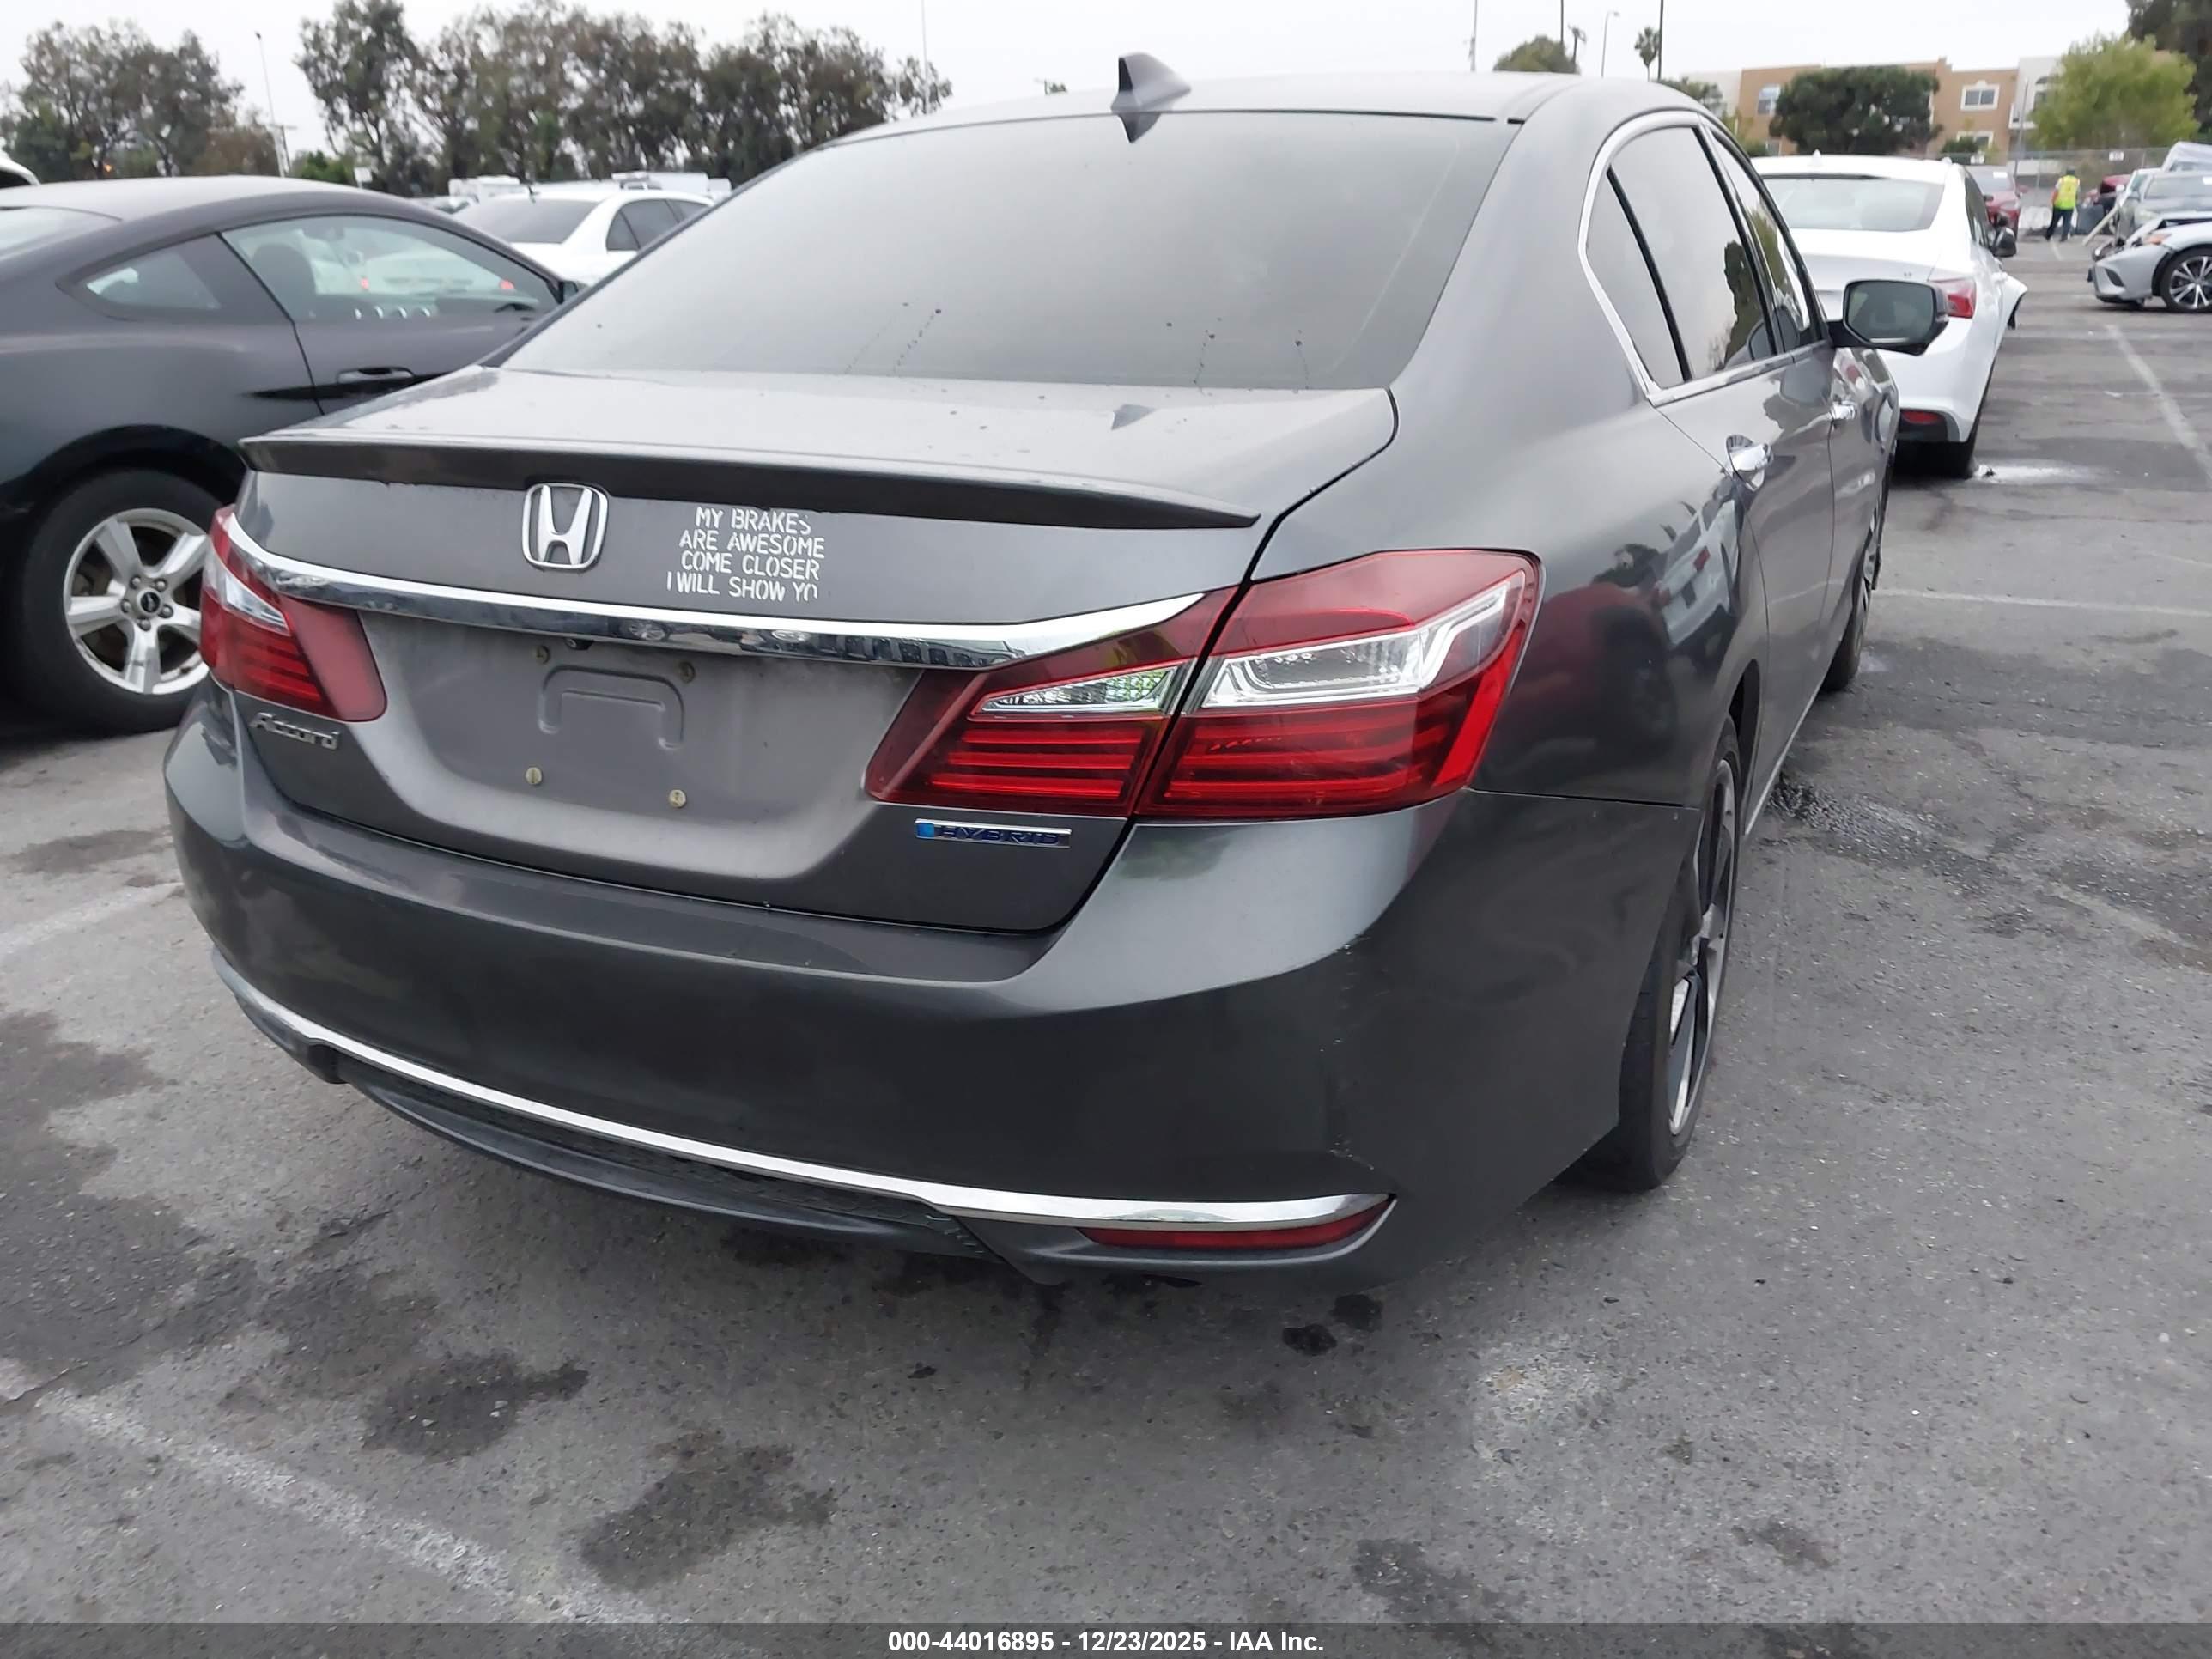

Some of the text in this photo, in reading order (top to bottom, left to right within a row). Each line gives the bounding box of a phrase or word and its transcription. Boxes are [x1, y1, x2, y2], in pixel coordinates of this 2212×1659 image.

[696, 507, 811, 535] MY BRAKES
[679, 529, 825, 559] ARE AWESOME
[681, 550, 819, 580] COME CLOSER
[666, 571, 673, 592] I
[677, 571, 720, 595] WILL
[728, 576, 785, 602] SHOW
